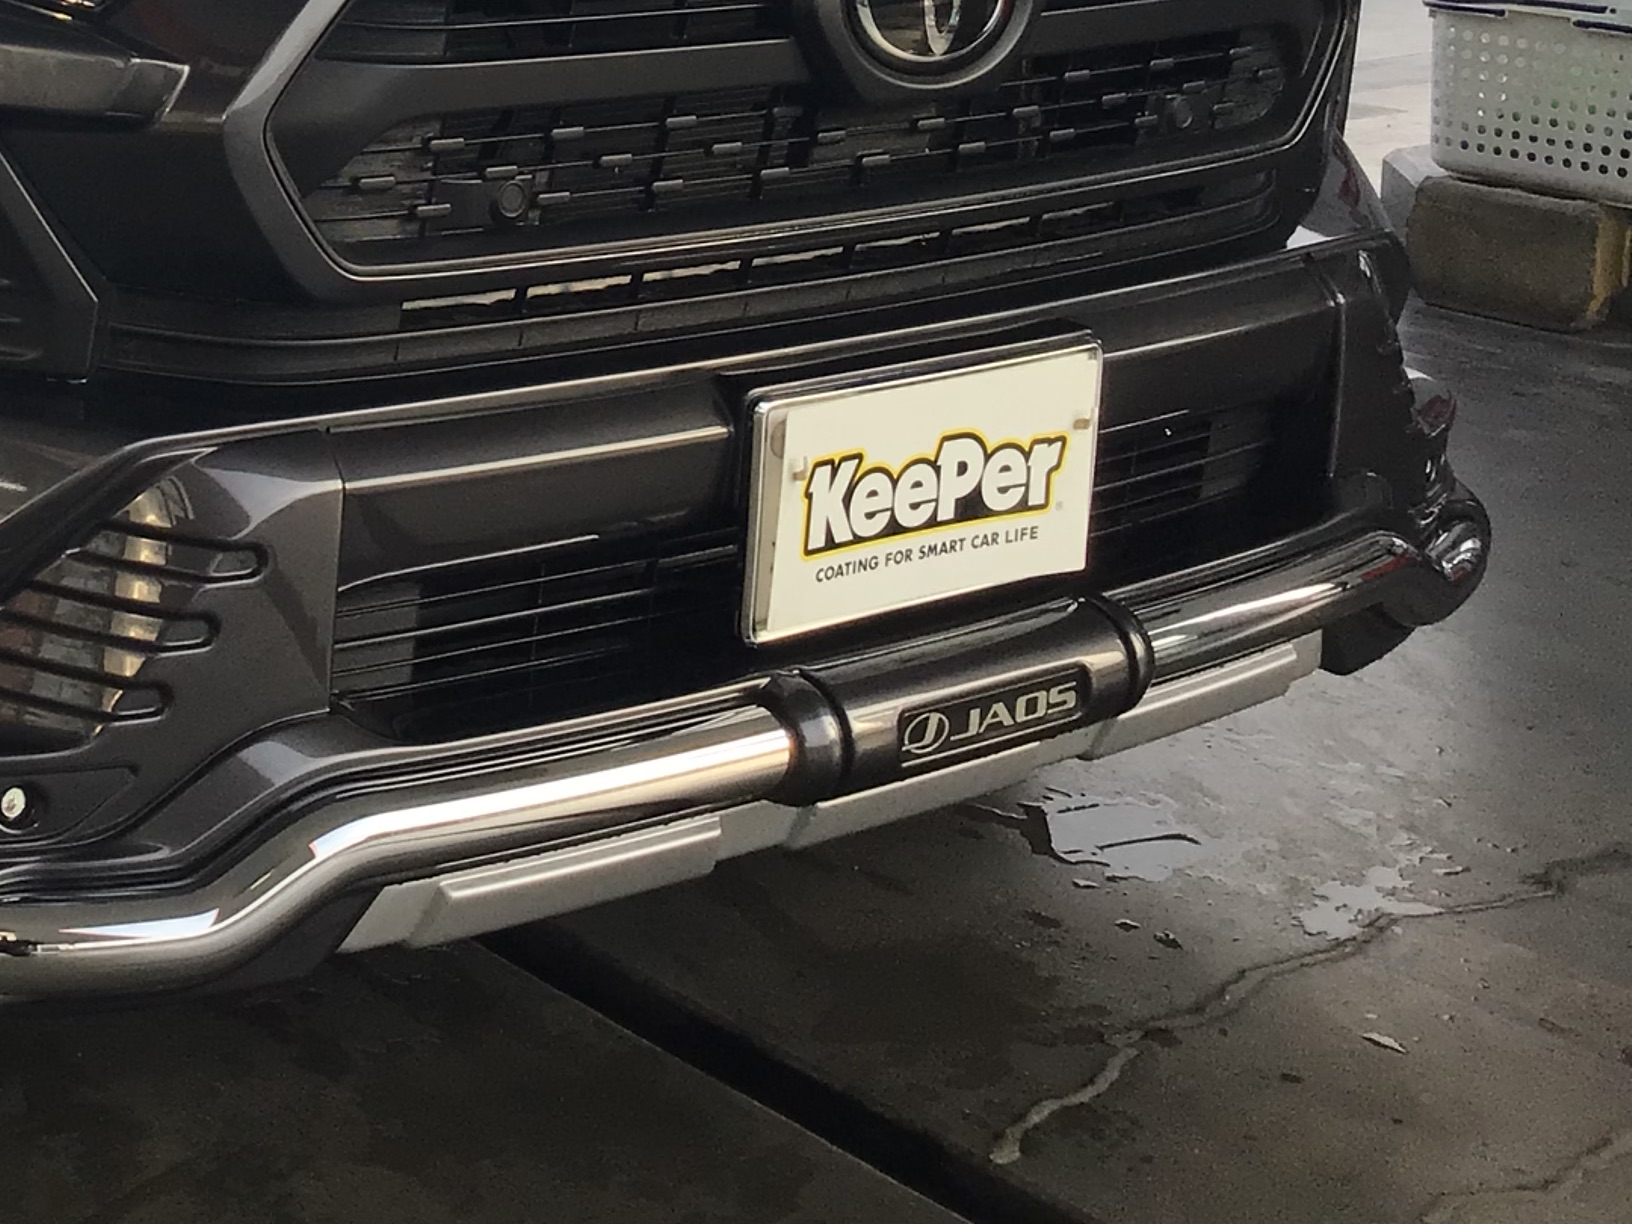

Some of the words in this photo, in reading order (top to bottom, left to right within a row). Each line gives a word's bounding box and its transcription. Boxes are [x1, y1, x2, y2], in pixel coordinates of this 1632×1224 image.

[805, 432, 1066, 555] KeePer
[814, 555, 880, 583] COATING
[884, 547, 914, 568] FOR
[918, 536, 967, 561] SMART
[970, 531, 1001, 550] CAR
[1004, 525, 1040, 544] LIFE
[949, 680, 1078, 741] JAOS
